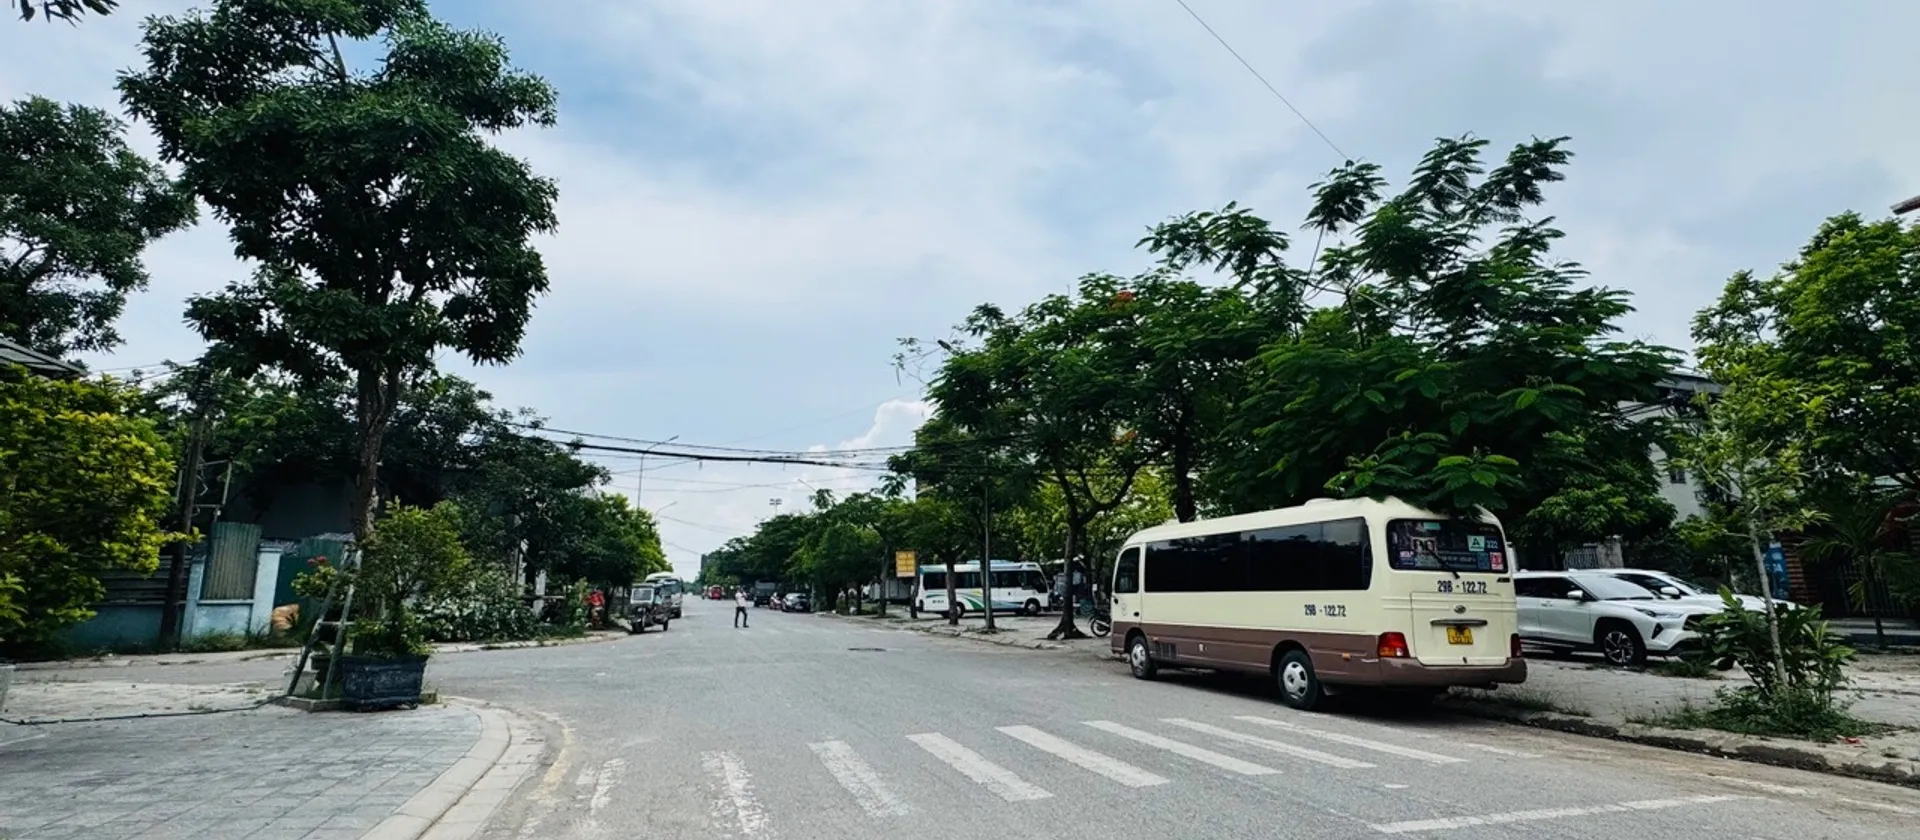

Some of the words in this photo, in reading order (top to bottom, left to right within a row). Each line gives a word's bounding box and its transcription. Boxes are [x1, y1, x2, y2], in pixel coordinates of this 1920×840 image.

[1437, 580, 1453, 593] 29B
[1462, 580, 1488, 594] 122.72
[1304, 604, 1317, 616] 29B
[1323, 604, 1347, 617] 122.72
